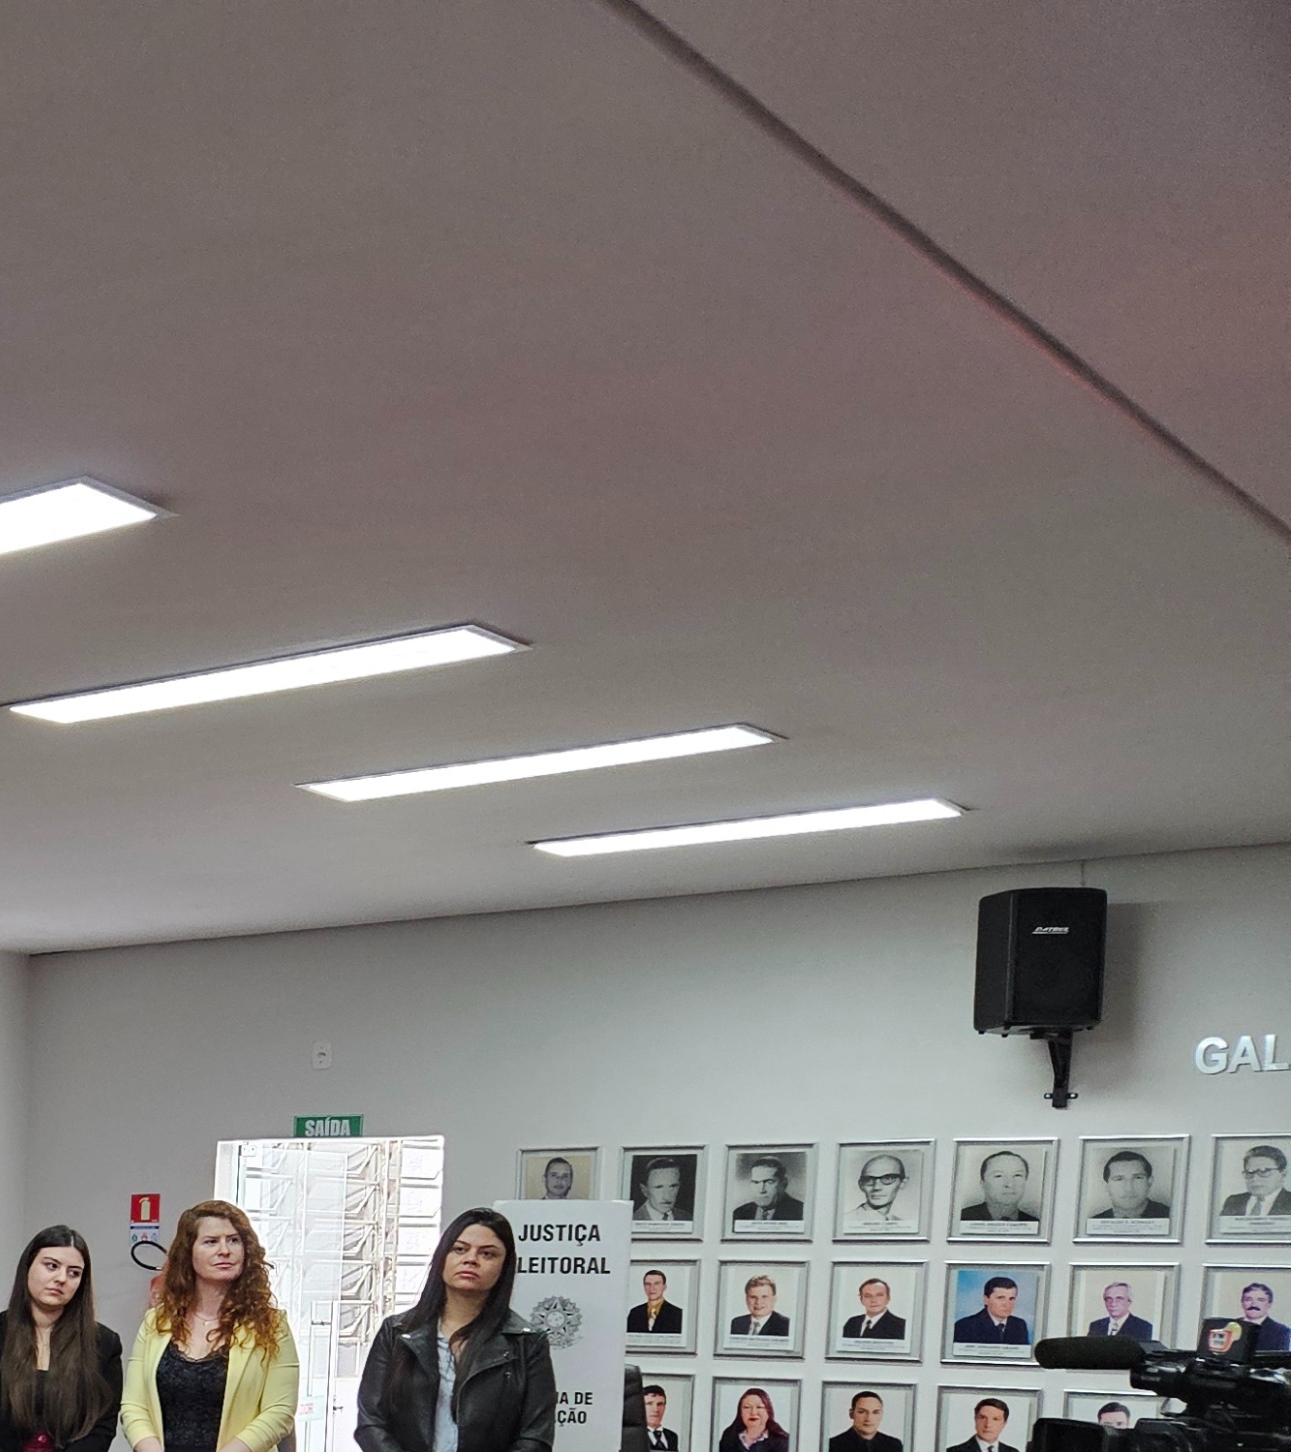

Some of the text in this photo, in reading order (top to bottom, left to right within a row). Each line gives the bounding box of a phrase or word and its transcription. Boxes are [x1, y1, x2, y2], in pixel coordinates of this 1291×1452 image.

[304, 1116, 351, 1137] SAÍDA
[518, 1224, 601, 1247] JUSTIÇA
[574, 1391, 594, 1406] DE
